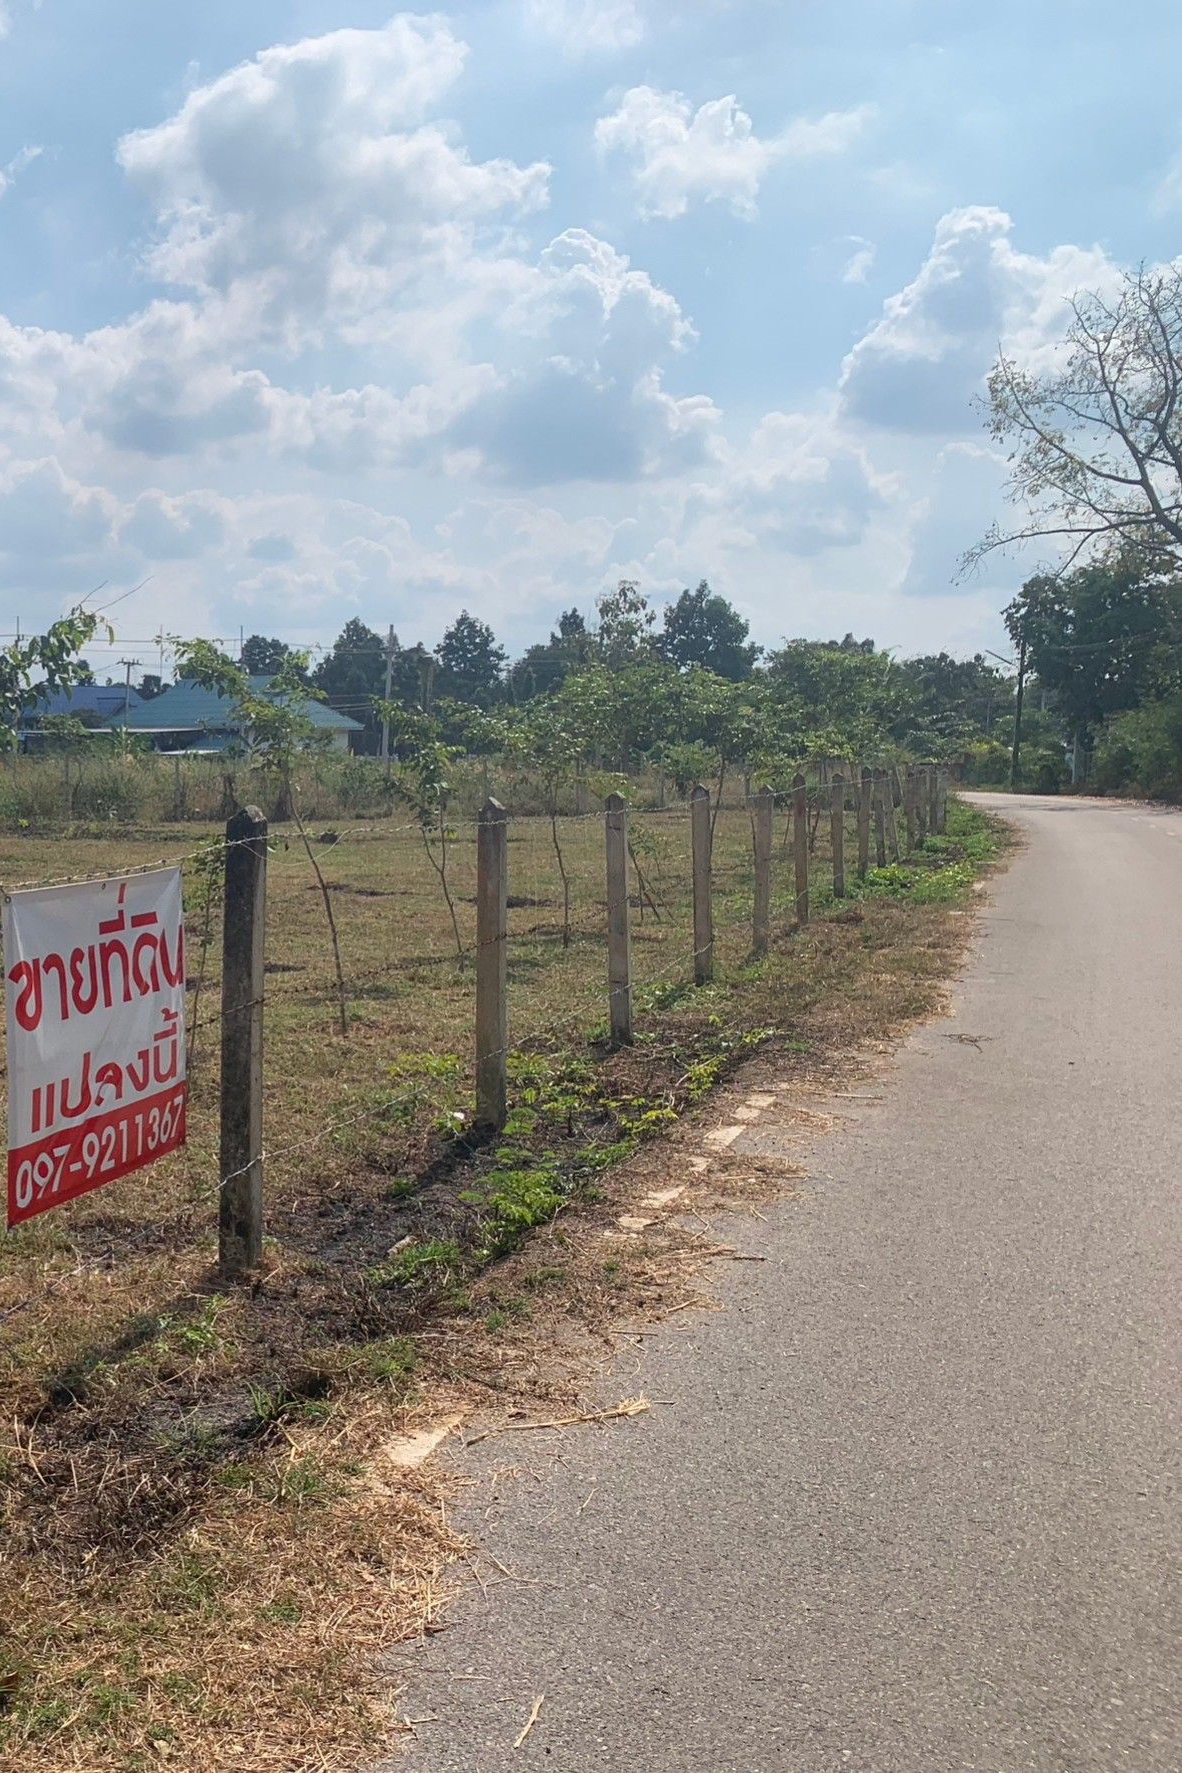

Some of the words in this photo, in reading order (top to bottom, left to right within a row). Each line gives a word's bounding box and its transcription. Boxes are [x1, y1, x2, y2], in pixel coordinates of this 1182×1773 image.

[8, 883, 183, 1031] ขายที่ดิน
[32, 1007, 178, 1133] แปลงนี้
[16, 1094, 183, 1208] 097-9211367
